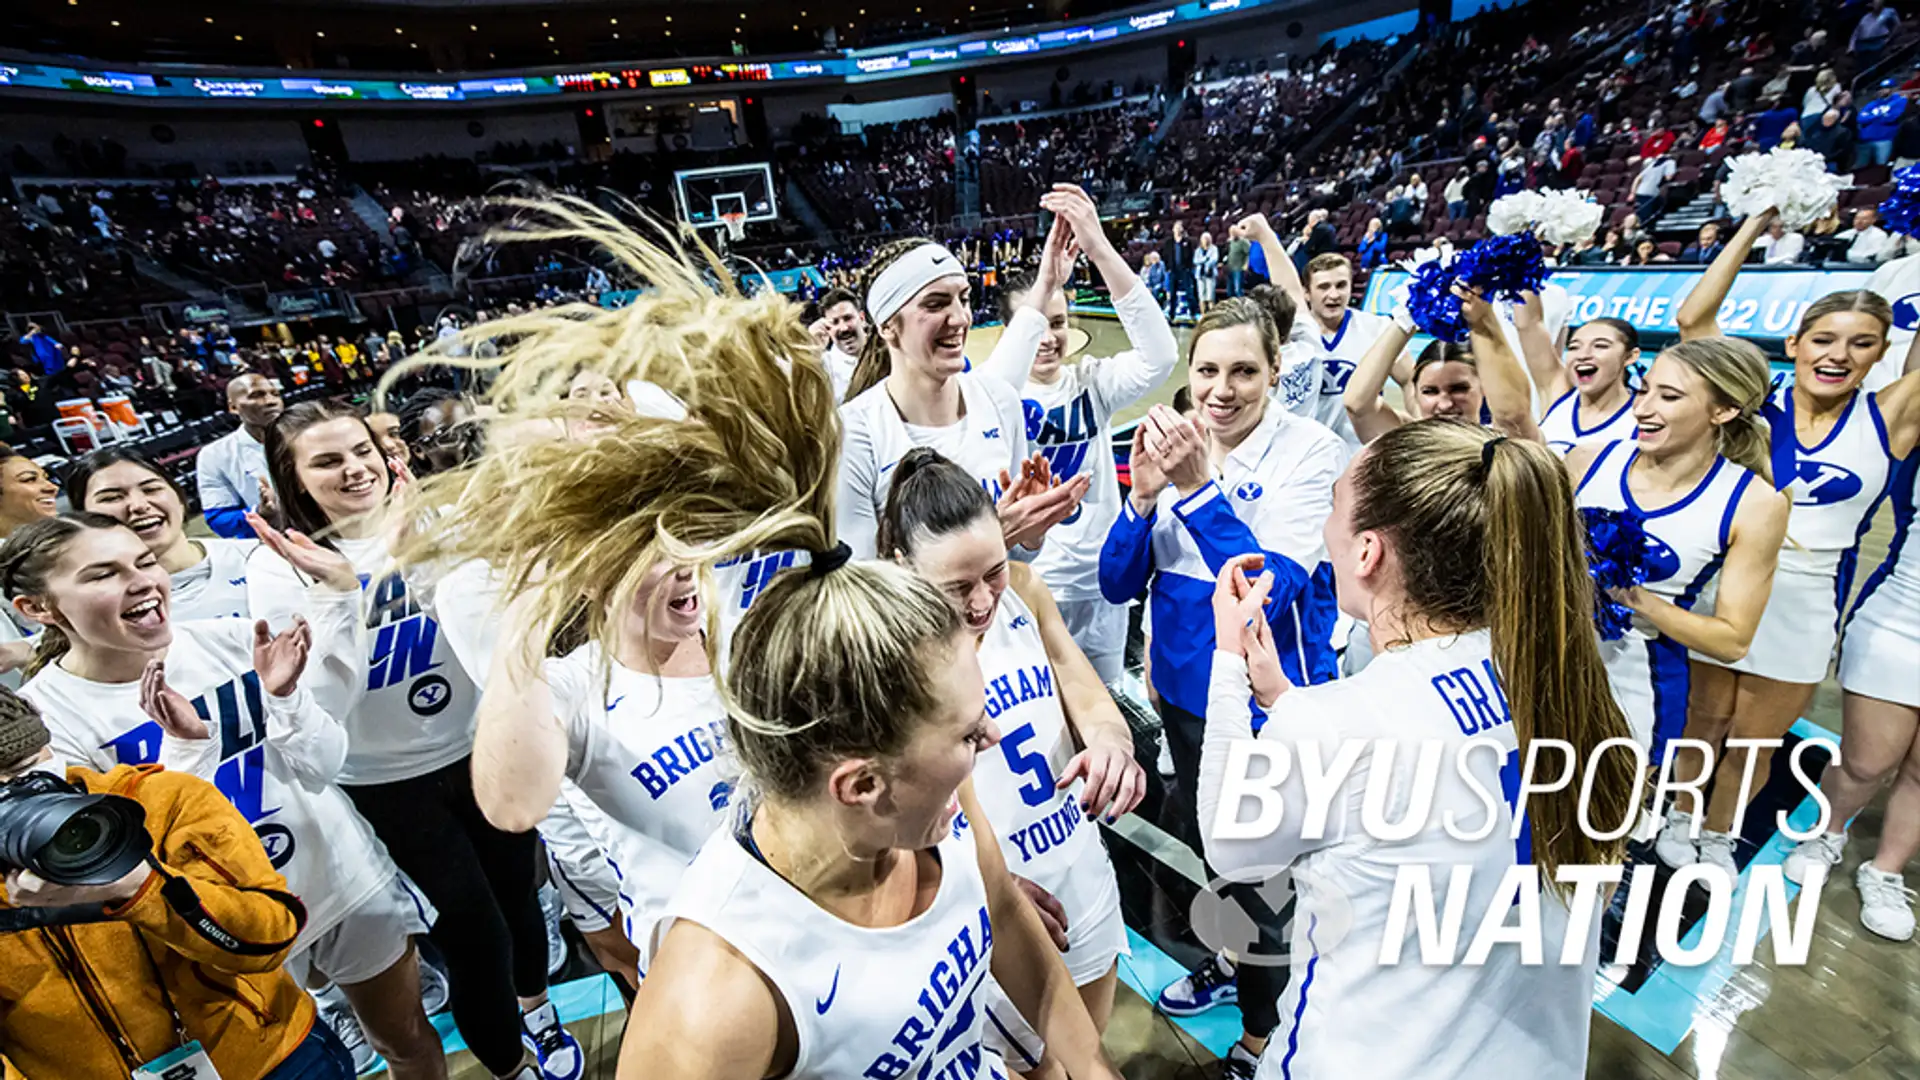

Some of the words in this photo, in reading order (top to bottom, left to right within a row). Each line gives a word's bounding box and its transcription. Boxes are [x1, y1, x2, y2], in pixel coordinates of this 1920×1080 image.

[1568, 294, 1604, 321] TO
[1612, 295, 1670, 326] THE
[1668, 297, 1758, 330] 22
[1020, 388, 1098, 446] BALL
[1000, 722, 1057, 808] 5
[1008, 793, 1081, 863] YOUNG
[199, 918, 240, 949] Canon
